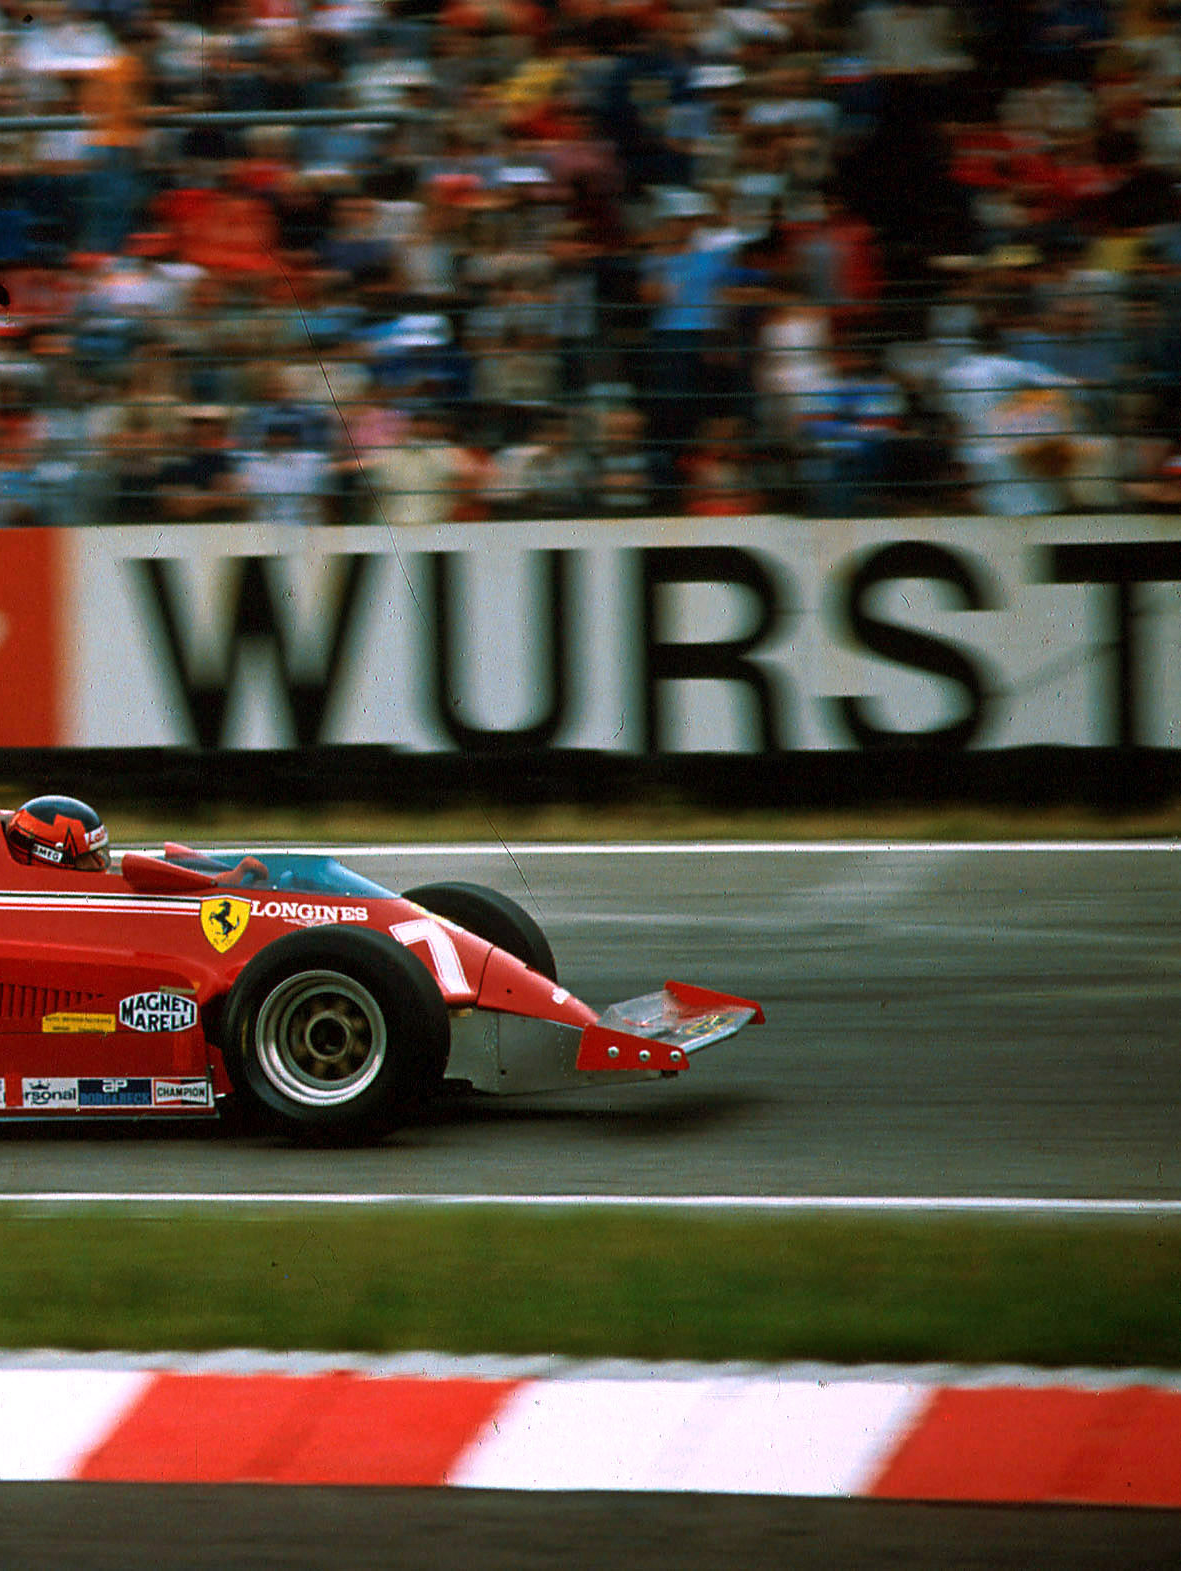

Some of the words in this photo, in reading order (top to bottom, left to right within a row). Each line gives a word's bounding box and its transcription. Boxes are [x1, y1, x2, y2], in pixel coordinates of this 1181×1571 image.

[124, 541, 1181, 754] WURST
[250, 900, 368, 922] LONGINES
[388, 918, 472, 994] 7
[121, 993, 195, 1015] MAGNETI
[121, 1009, 195, 1031] MARELLI
[156, 1086, 206, 1098] CHAMPION
